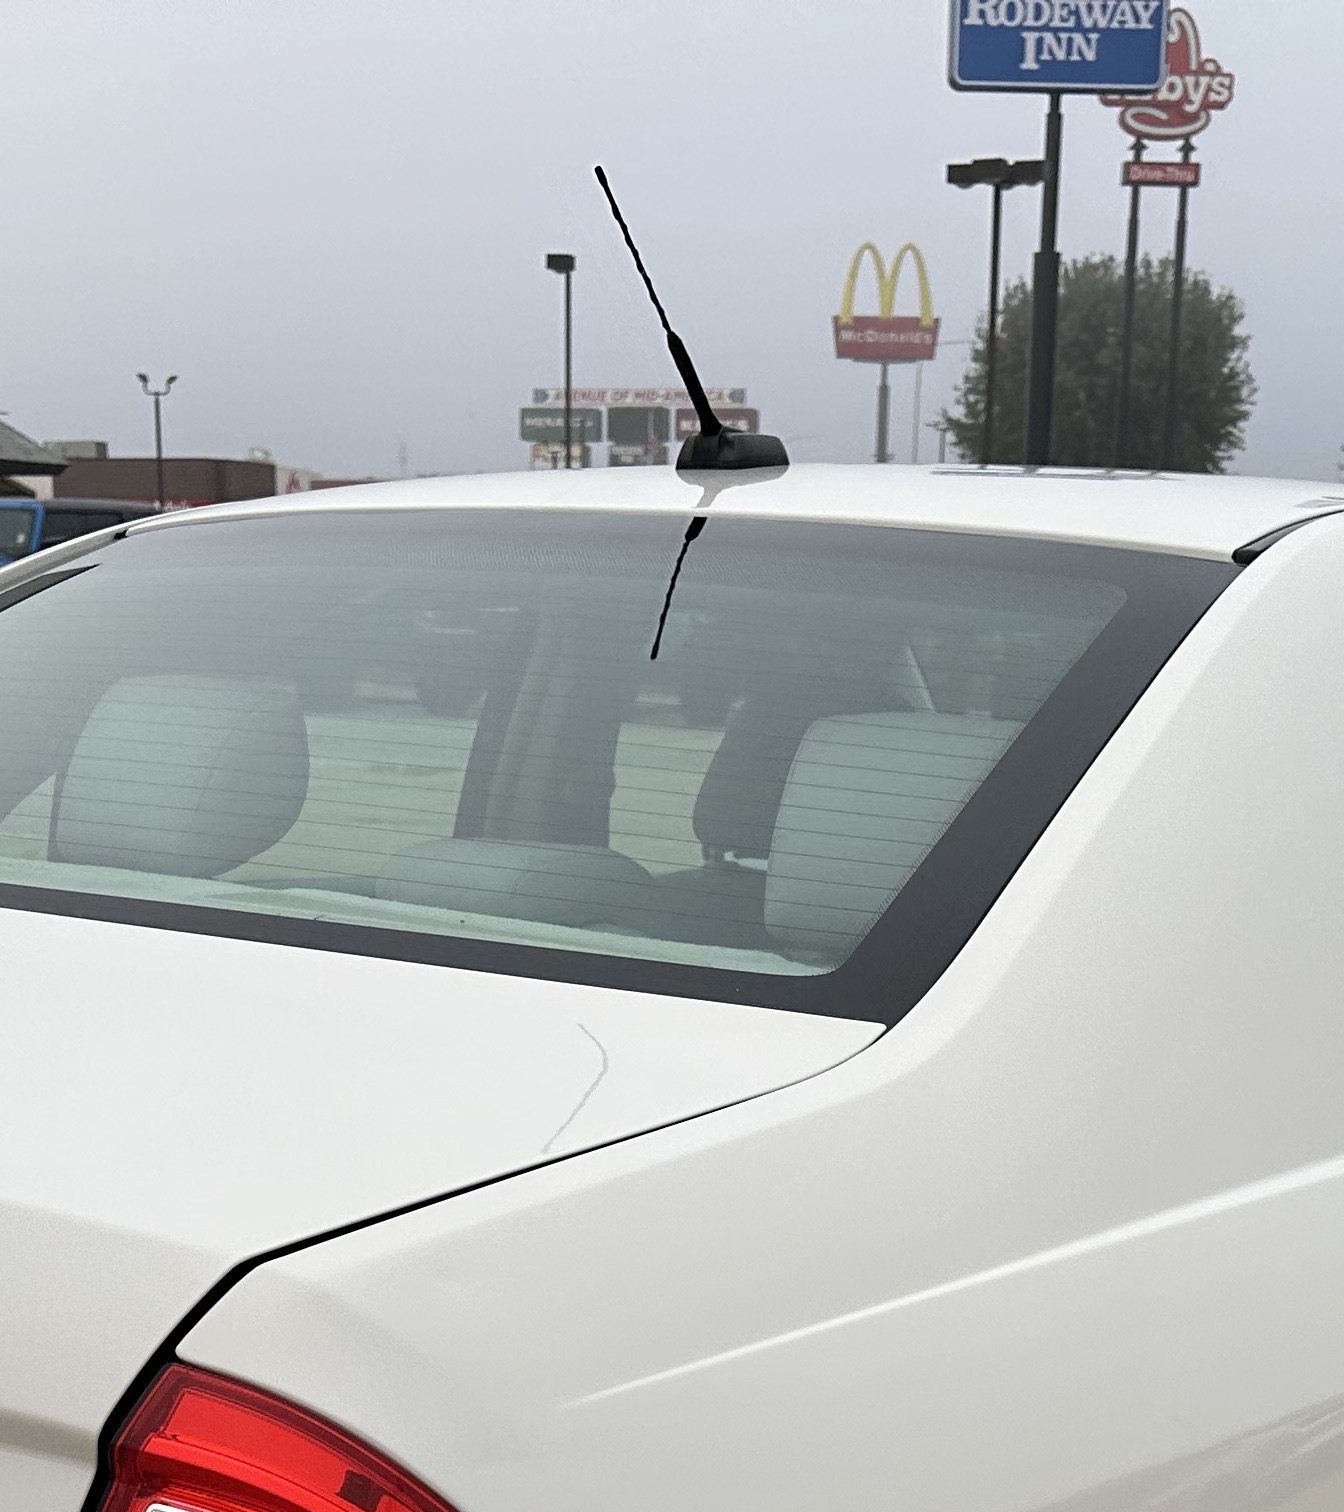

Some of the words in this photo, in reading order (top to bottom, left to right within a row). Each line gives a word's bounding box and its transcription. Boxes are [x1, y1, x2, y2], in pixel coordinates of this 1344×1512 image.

[962, 0, 1159, 29] RODEWAY
[1018, 32, 1101, 70] INN
[552, 385, 607, 402] AENUE
